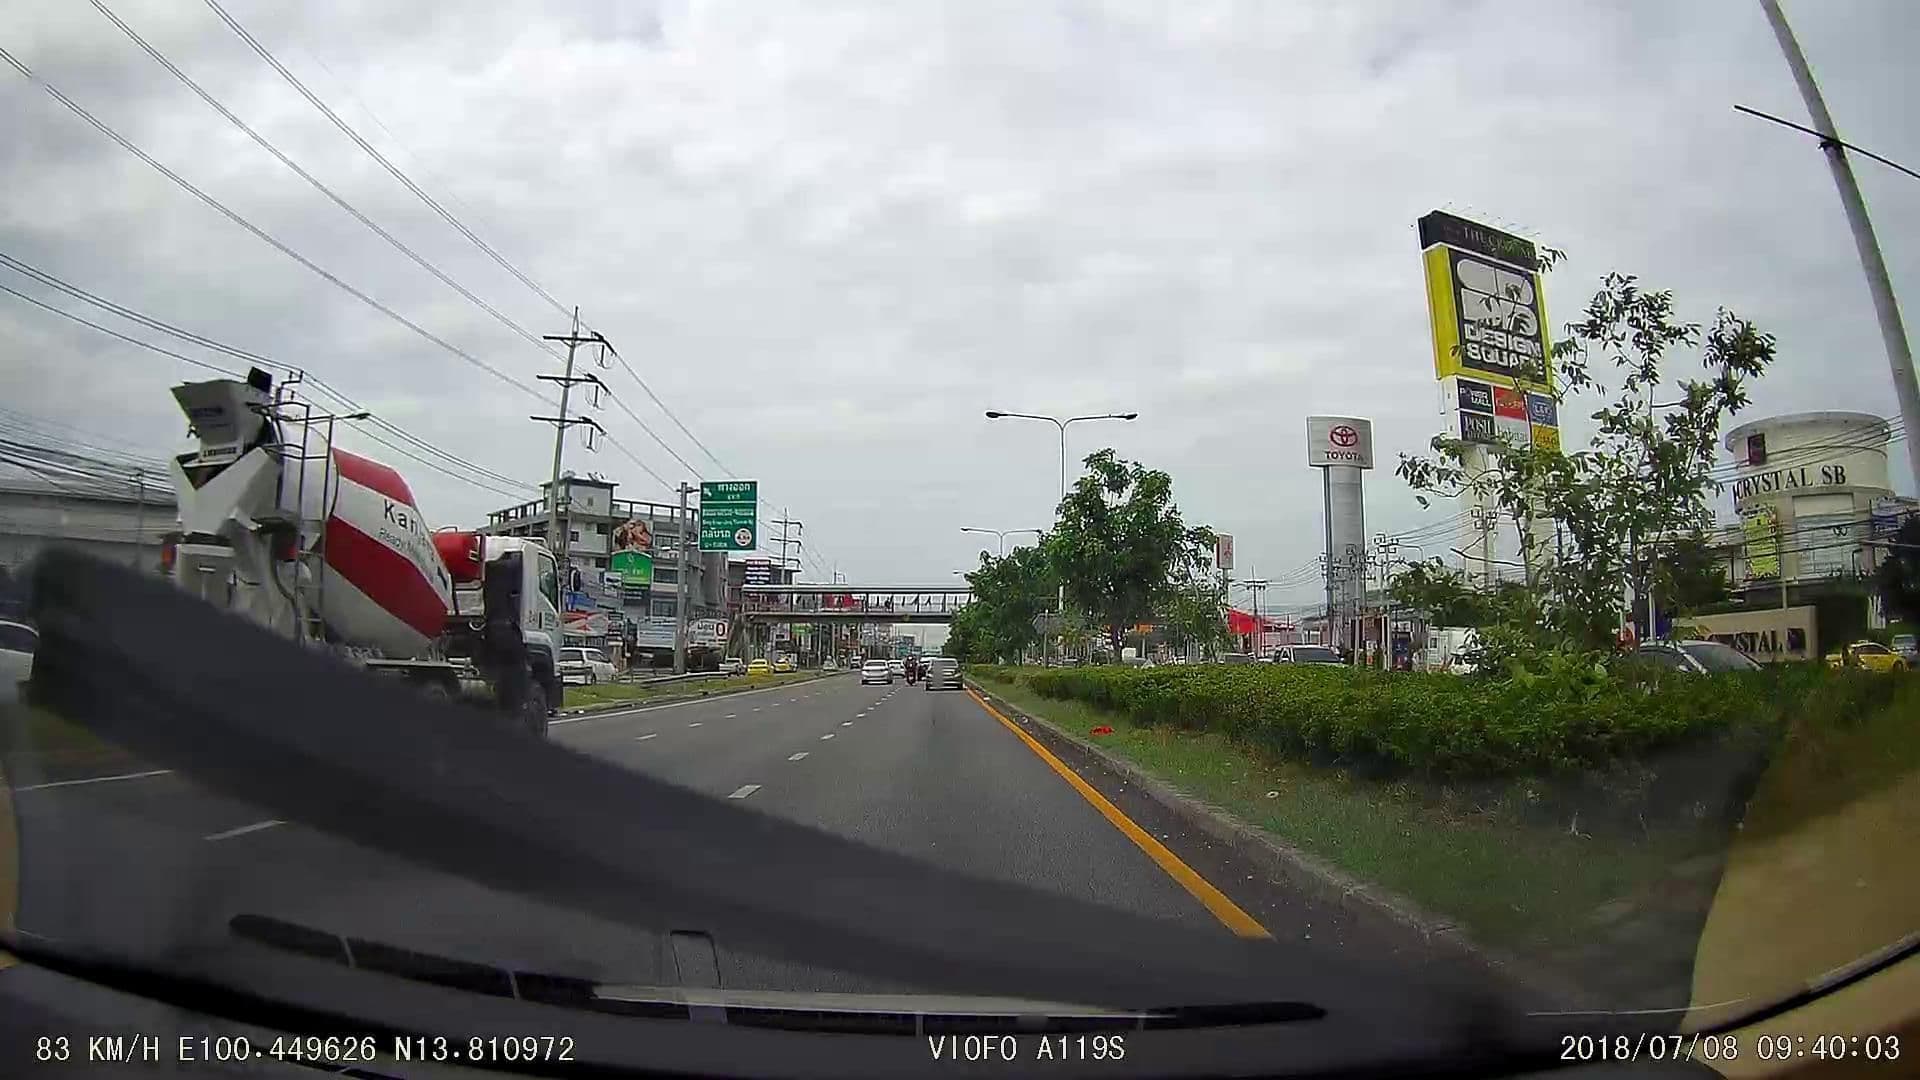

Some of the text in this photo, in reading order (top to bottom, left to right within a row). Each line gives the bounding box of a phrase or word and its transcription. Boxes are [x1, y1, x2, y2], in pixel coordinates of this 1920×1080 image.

[1464, 323, 1542, 358] DESIGN
[1323, 450, 1365, 462] TOYOTA
[1735, 465, 1846, 500] CRYSTAL SB
